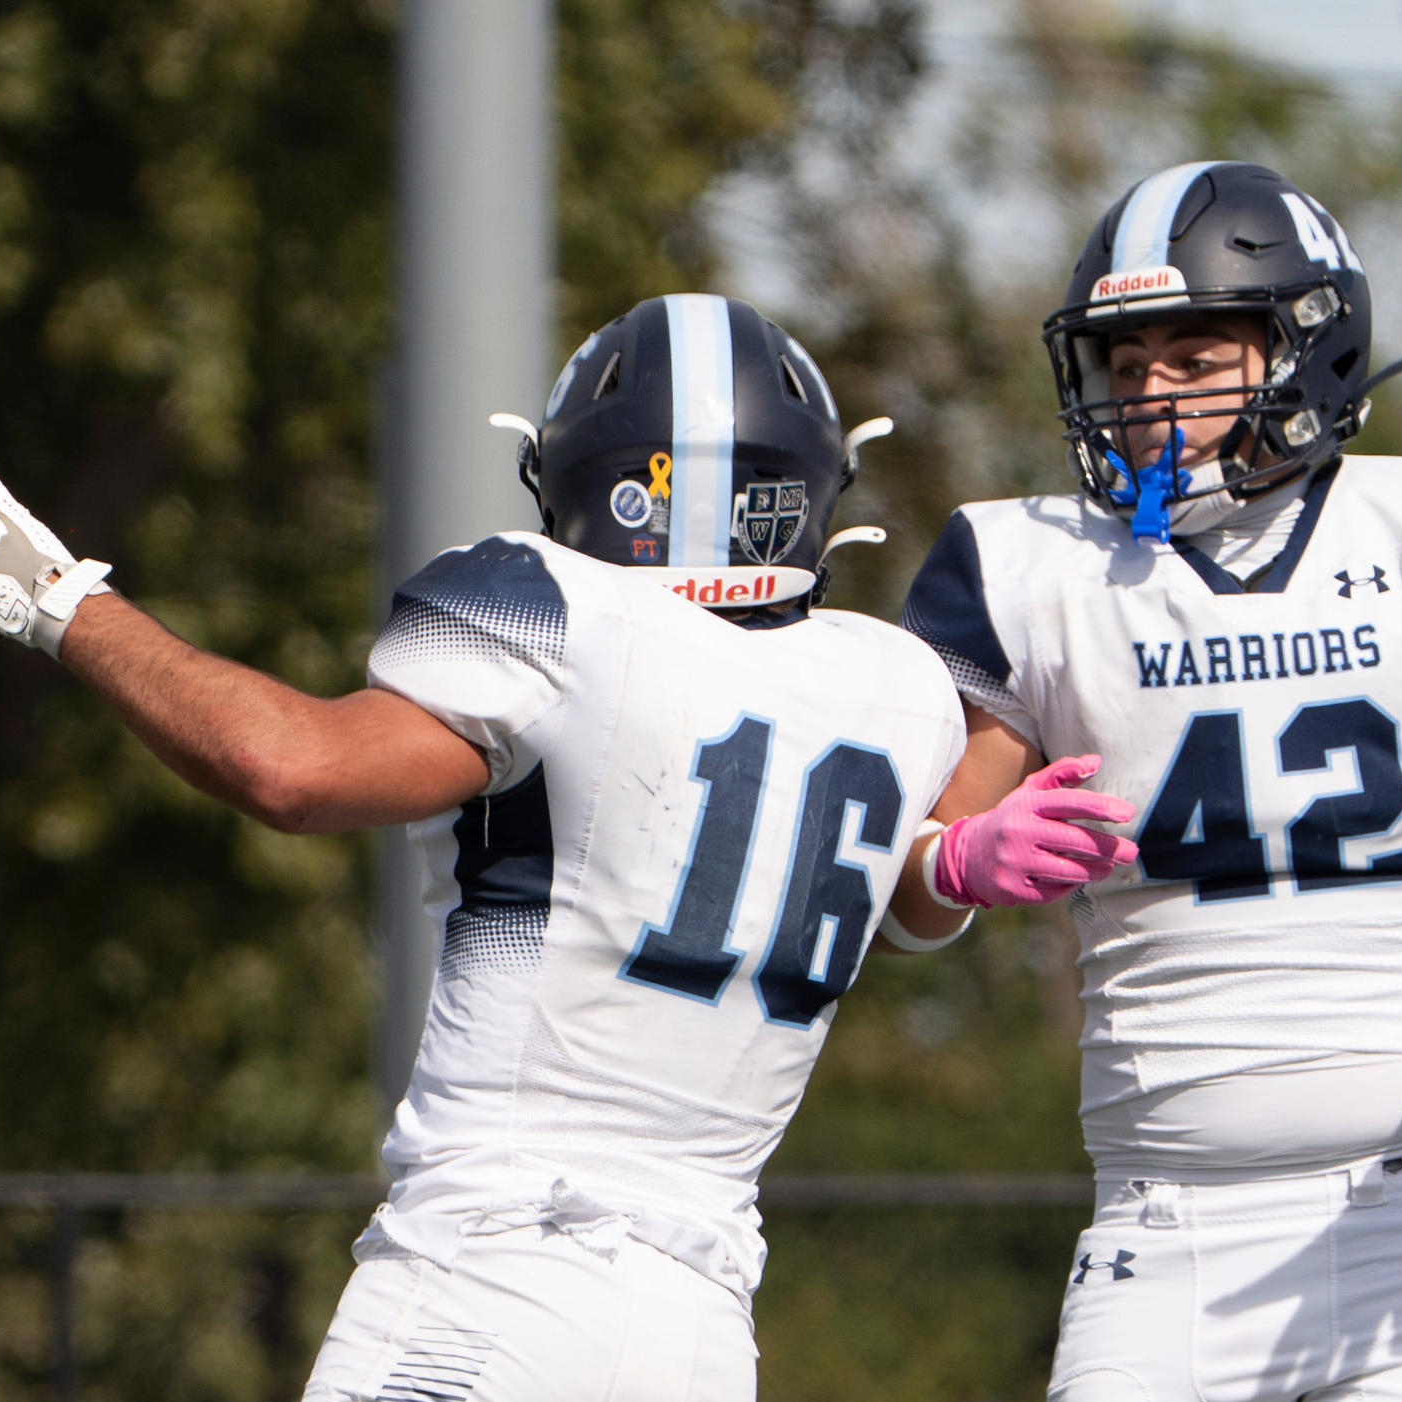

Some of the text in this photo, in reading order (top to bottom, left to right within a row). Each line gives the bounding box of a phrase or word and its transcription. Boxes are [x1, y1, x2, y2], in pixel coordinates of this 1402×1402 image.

[1099, 272, 1169, 297] Riddell
[751, 521, 770, 541] W
[632, 539, 657, 558] PT
[664, 575, 776, 603] ddell
[1133, 623, 1381, 689] WARRIORS
[617, 711, 905, 1031] 16
